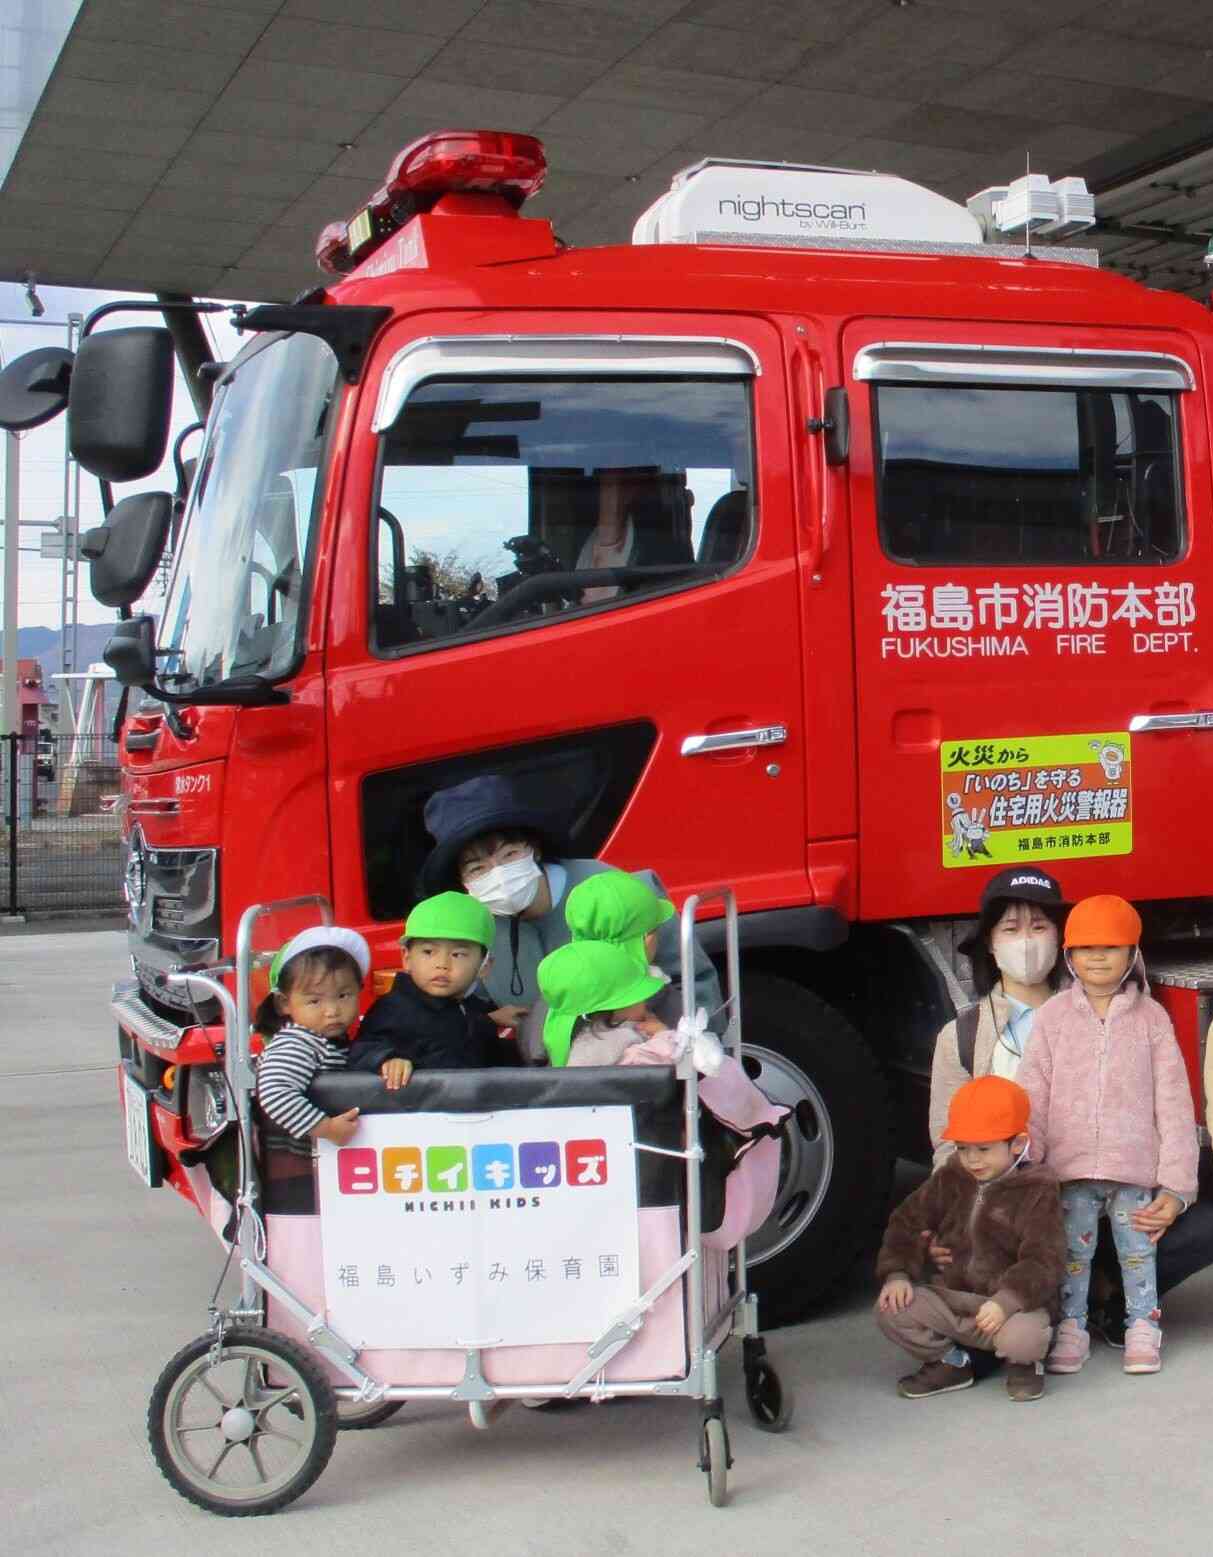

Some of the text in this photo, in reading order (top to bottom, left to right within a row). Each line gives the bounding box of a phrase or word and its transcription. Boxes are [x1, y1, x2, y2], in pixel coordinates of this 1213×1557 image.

[719, 193, 866, 221] nightscan
[881, 582, 1196, 632] 福島市消防本部
[881, 631, 1199, 658] FUKUSHIMA FIRE DEPT.
[947, 744, 1030, 768] 火災から
[964, 768, 1082, 794] 「いのち」を守る
[990, 788, 1128, 827] 住宅用火災警報器
[1018, 832, 1112, 852] 福島市消防本部
[1010, 876, 1051, 889] ADIDAS
[349, 1154, 605, 1192] ニチイキッズ
[404, 1196, 542, 1212] NICHII KIDS
[338, 1253, 620, 1288] 福島いずみ保育園
